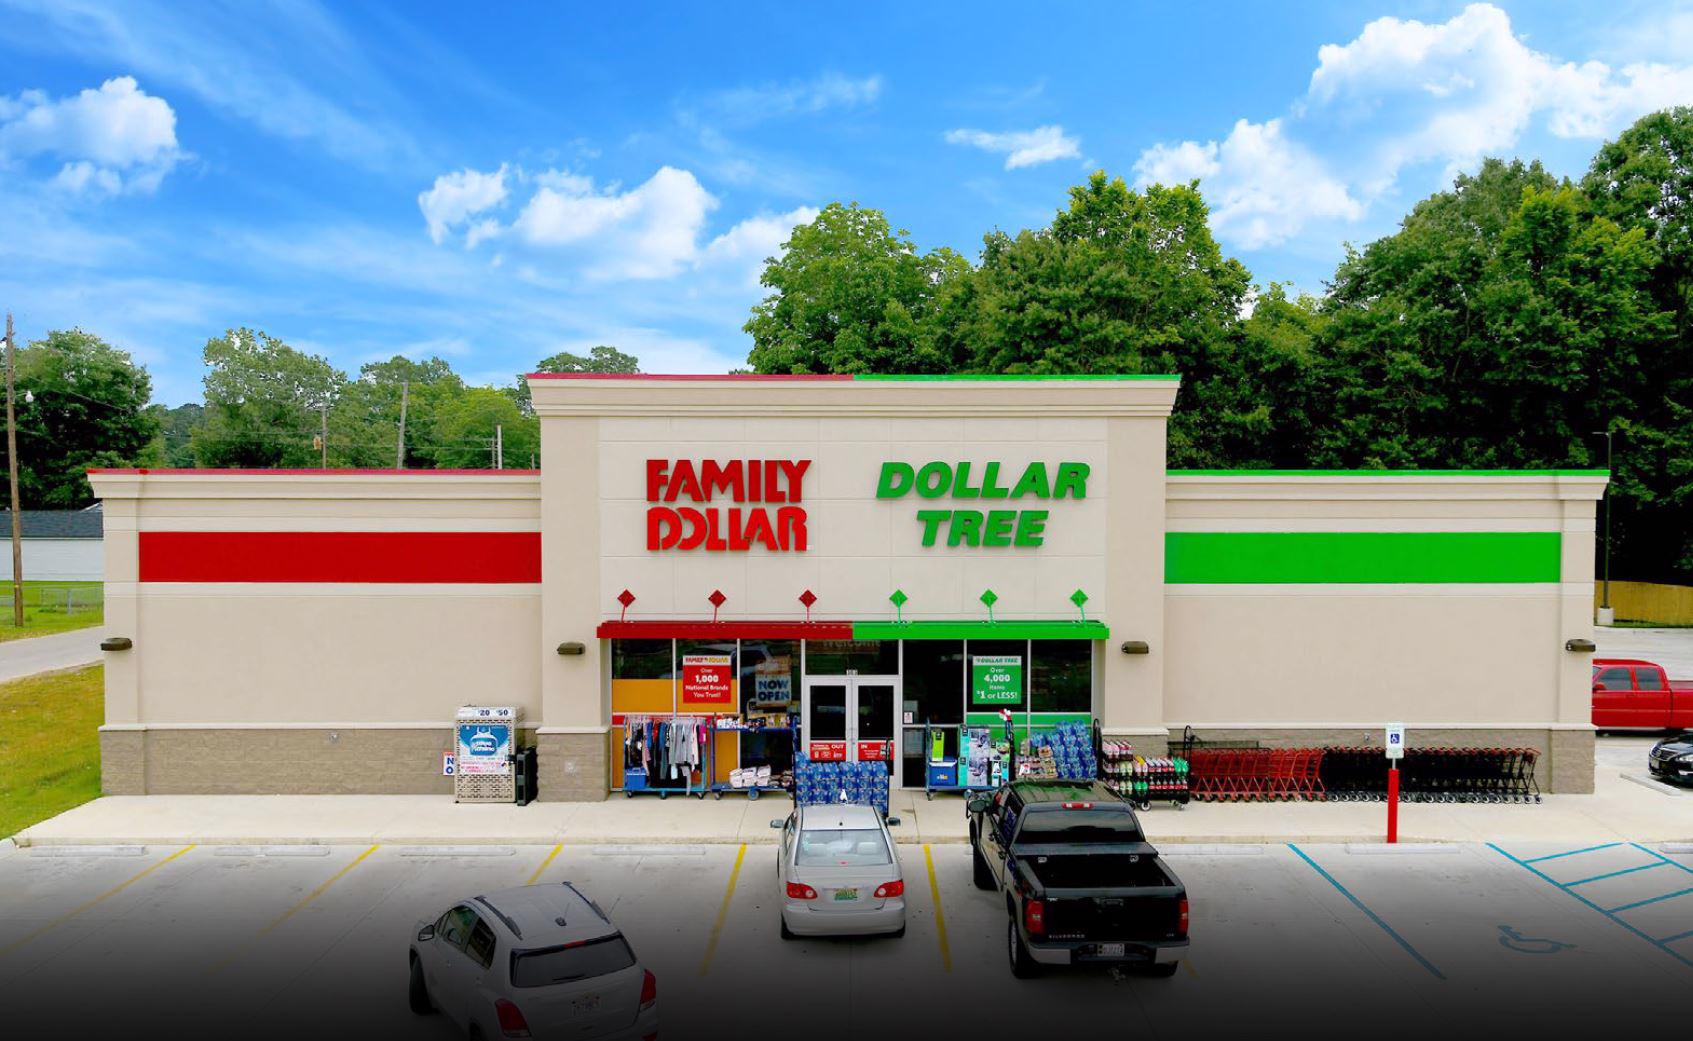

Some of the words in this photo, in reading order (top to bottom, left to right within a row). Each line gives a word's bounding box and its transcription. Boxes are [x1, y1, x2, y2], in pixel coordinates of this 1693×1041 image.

[646, 459, 812, 503] FAMILY
[876, 461, 1091, 499] DOLLAR
[646, 506, 808, 552] DOLLAR
[916, 510, 1049, 547] TREE
[695, 674, 719, 684] 1,000
[758, 680, 789, 690] NOW
[984, 674, 1010, 683] 4,000
[758, 691, 790, 701] OPEN
